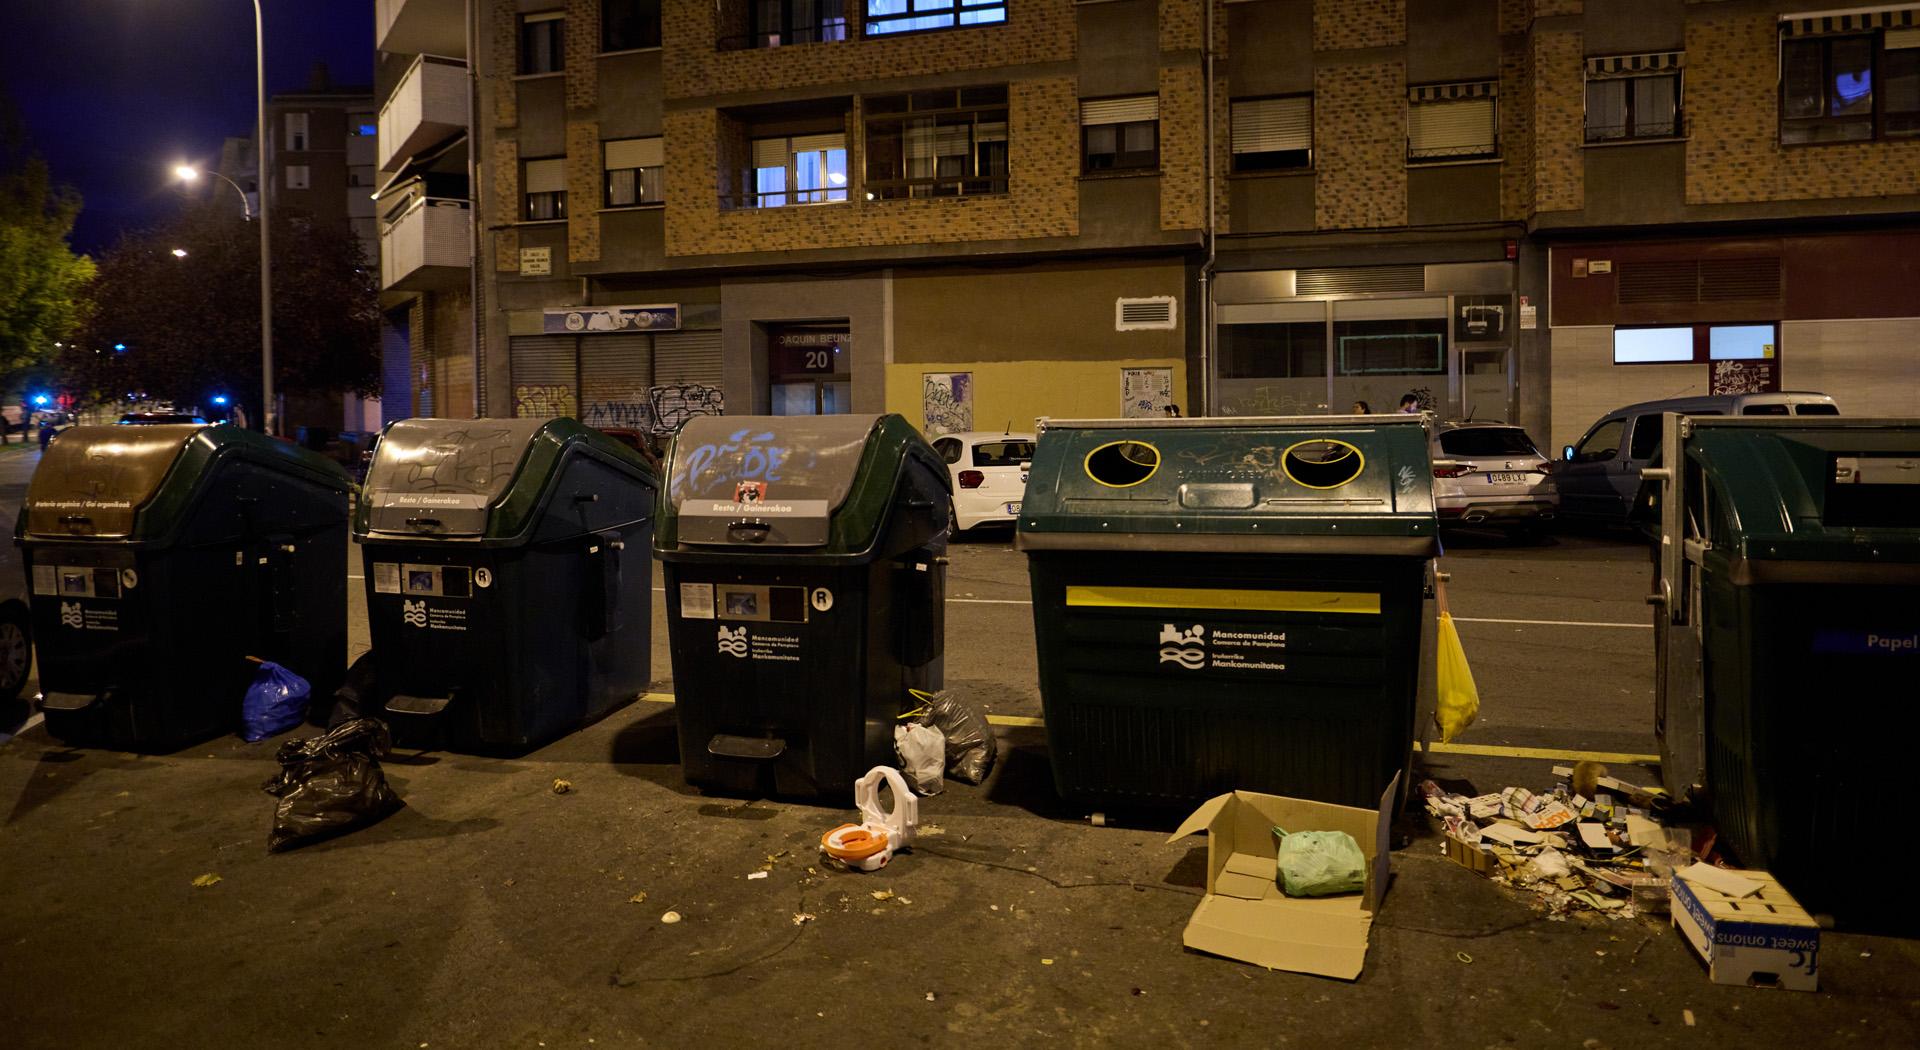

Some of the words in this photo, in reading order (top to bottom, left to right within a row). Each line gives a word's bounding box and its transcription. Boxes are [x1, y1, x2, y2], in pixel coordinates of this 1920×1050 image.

[805, 351, 828, 368] 20
[713, 503, 735, 512] Resto
[743, 503, 792, 513] Gainerakoa
[1212, 630, 1286, 640] Mancomunidad
[1867, 633, 1918, 652] Papel
[1212, 660, 1286, 670] Mankomunitatea
[1716, 932, 1766, 946] onions
[1771, 936, 1817, 950] sweet
